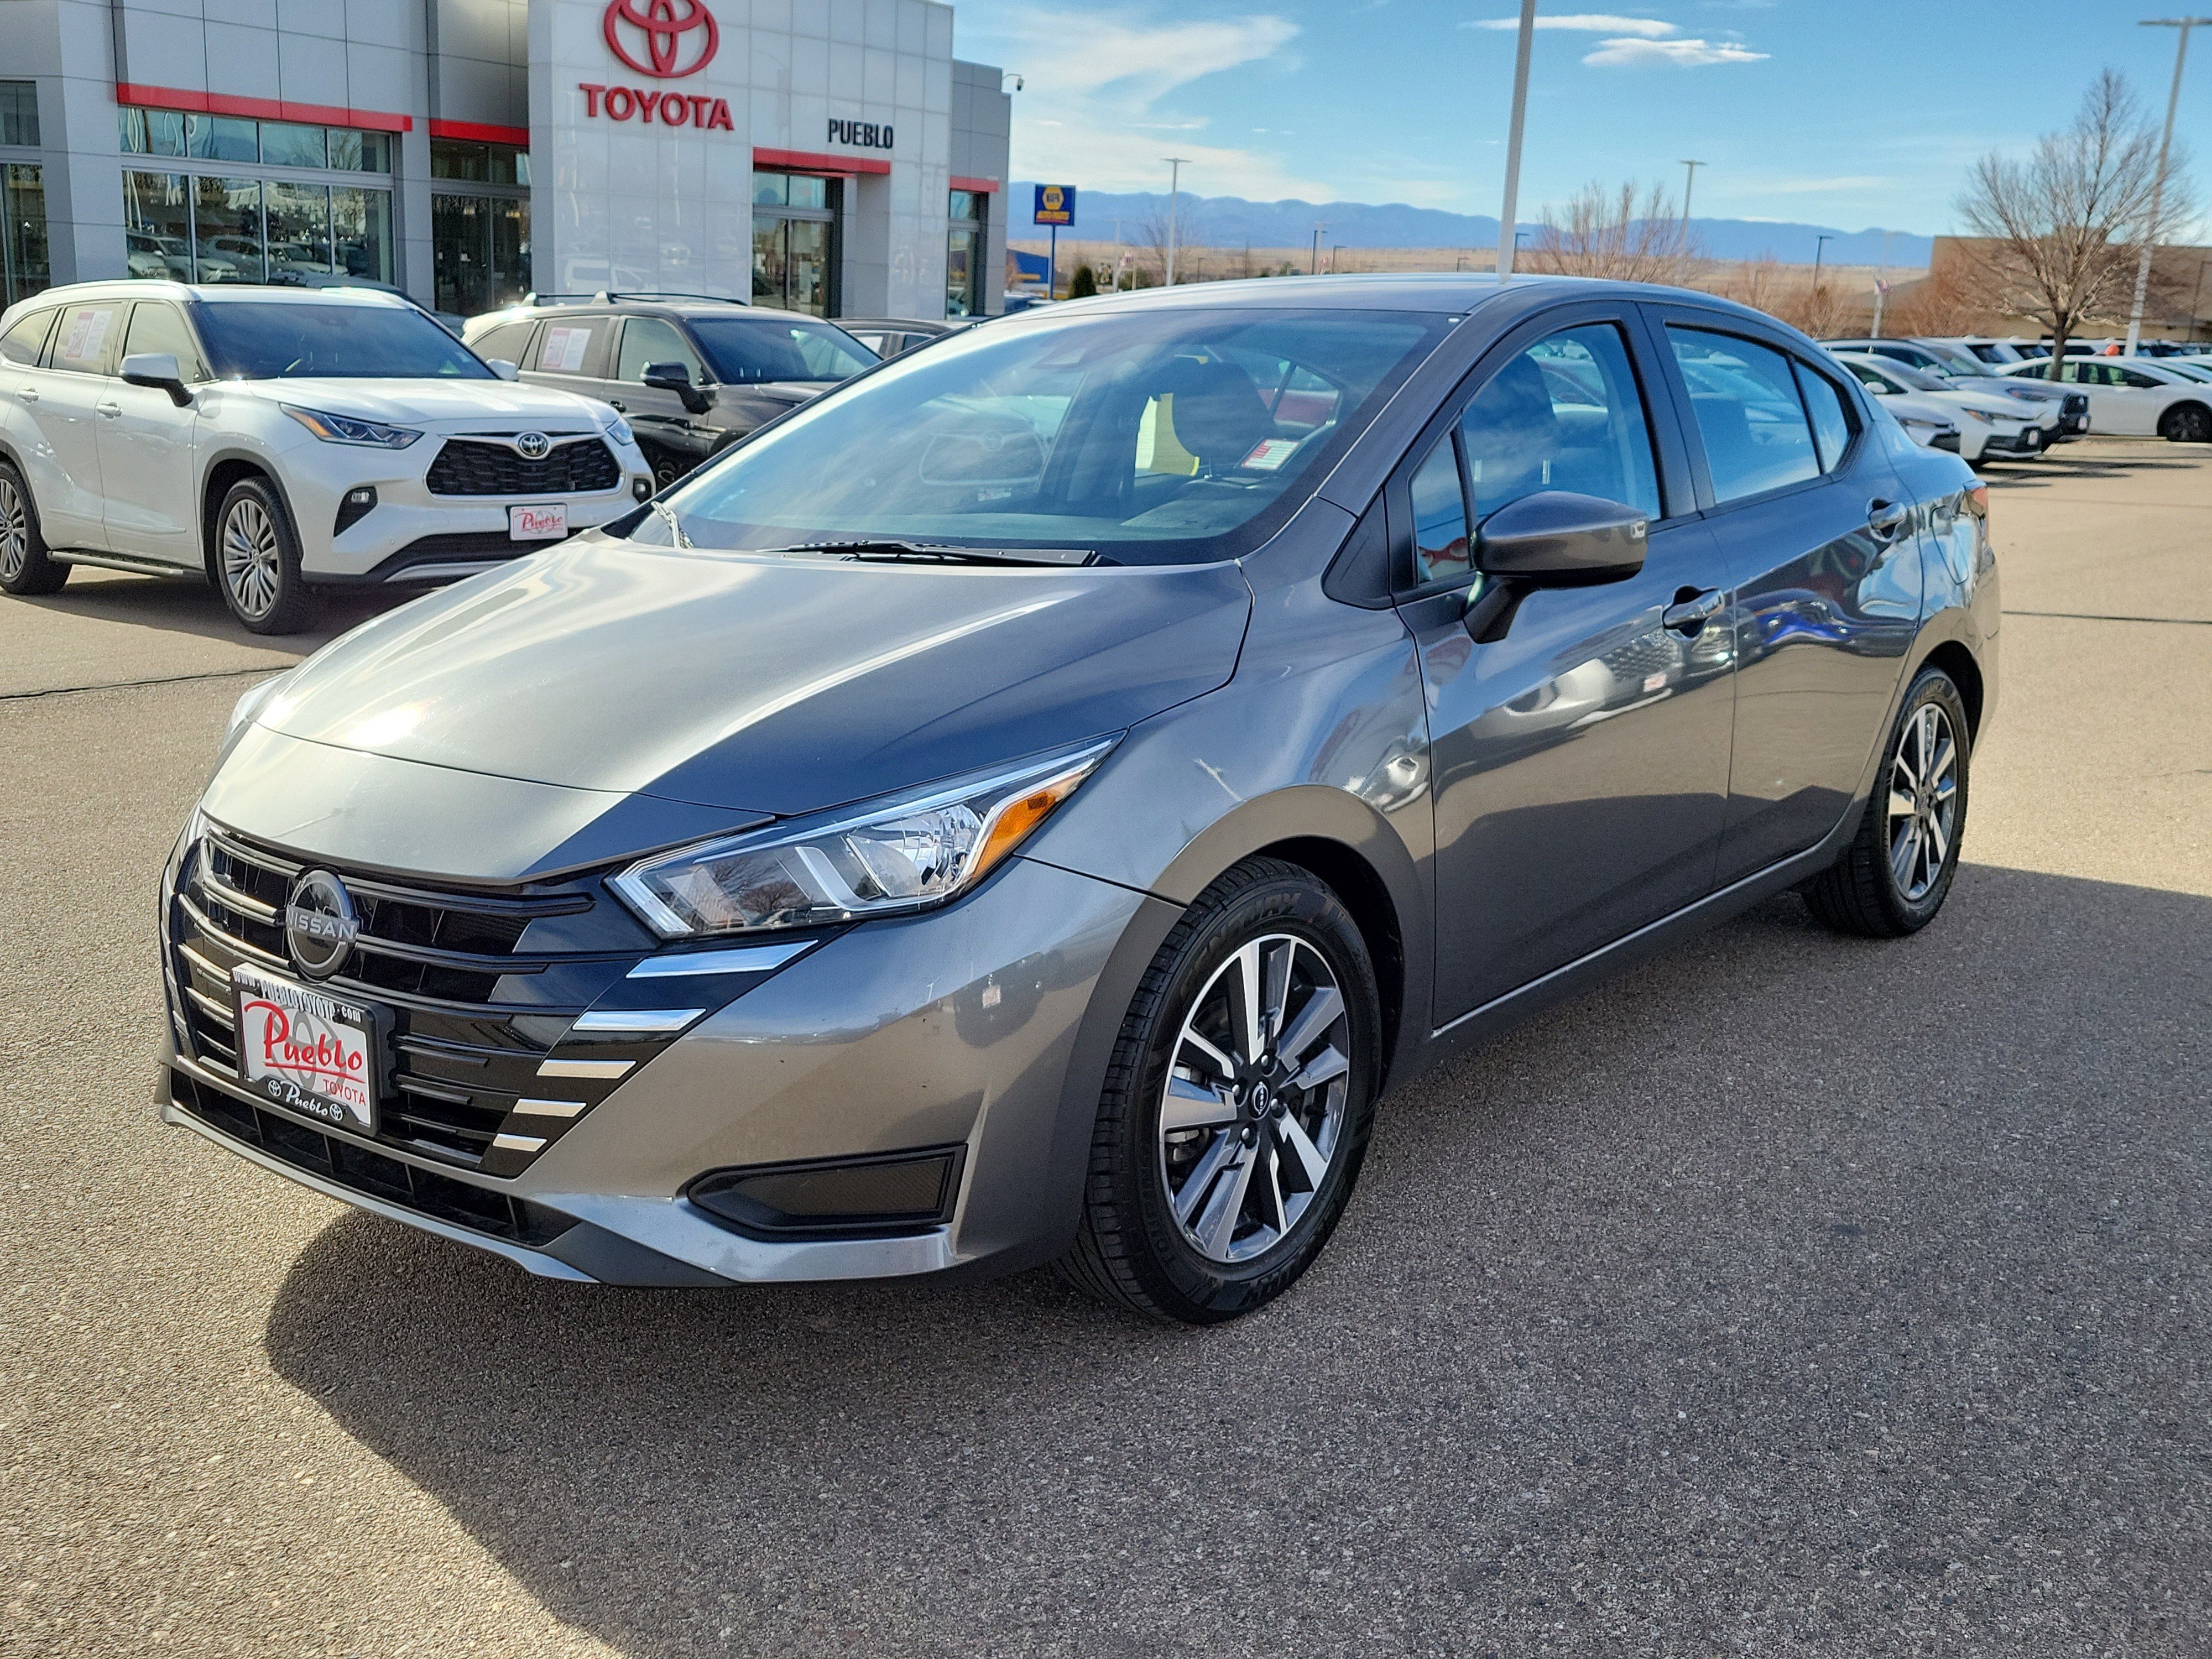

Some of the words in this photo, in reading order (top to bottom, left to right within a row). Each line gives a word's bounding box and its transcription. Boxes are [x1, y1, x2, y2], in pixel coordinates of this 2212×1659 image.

[579, 83, 734, 131] TOYOTA
[828, 118, 893, 149] PUEBLO
[286, 907, 354, 940] NISSAN
[244, 1000, 362, 1071] Pueblo
[280, 1078, 328, 1116] Pueblo
[324, 1078, 366, 1105] TOYOTA
